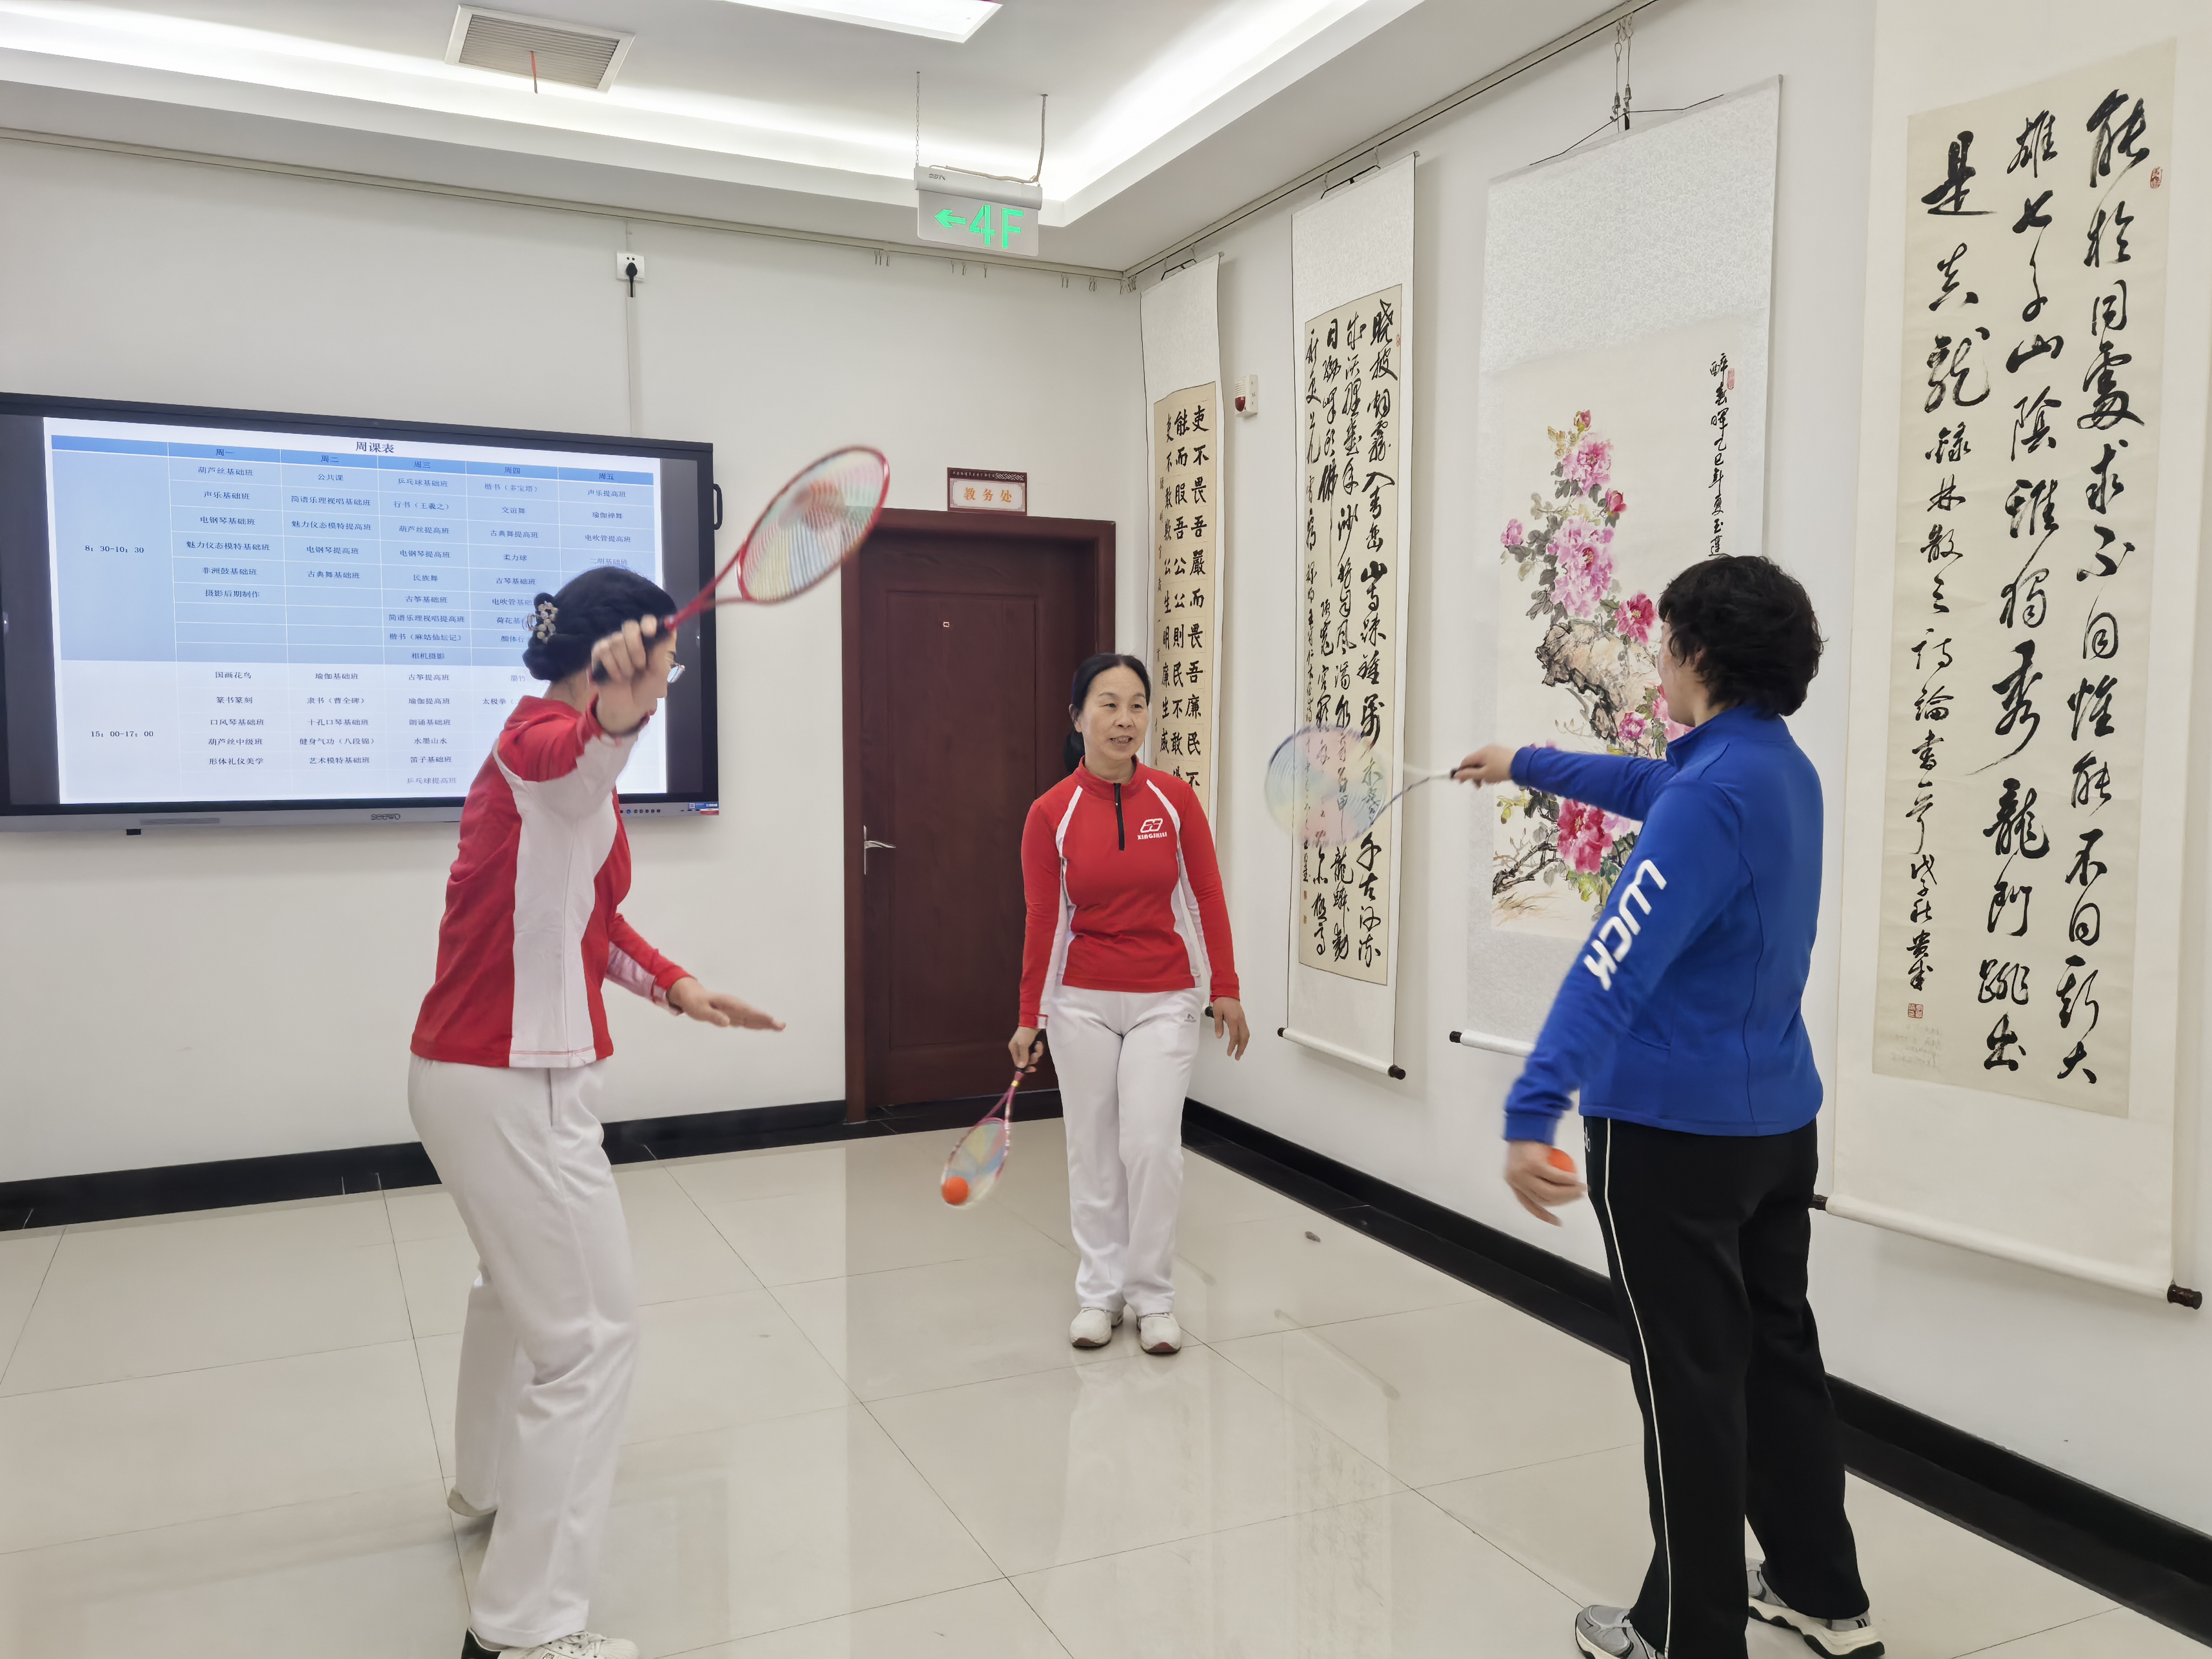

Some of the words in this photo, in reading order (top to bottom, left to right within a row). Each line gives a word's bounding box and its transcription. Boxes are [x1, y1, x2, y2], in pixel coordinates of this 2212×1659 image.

[969, 204, 1023, 248] 4F
[215, 448, 234, 456] 周一
[355, 441, 395, 454] 周课表
[320, 455, 339, 463] 周二
[414, 461, 431, 469] 周三
[198, 466, 254, 476] 葫芦丝基础班
[398, 478, 448, 487] 乒乓球基础班
[204, 491, 250, 500] 声乐基础班
[588, 489, 626, 497] 声乐提高班
[964, 487, 1013, 503] 教务处
[291, 495, 371, 506] 简谱乐理视唱基础班
[200, 516, 255, 525] 电钢琴基础班
[291, 520, 372, 530] 魅力仪态模特提高班
[399, 525, 449, 534] 葫芦丝提高班
[490, 530, 538, 538] 古典舞提高班
[585, 534, 631, 543] 电吹管提高班
[186, 541, 270, 550] 魅力仪态模特基础班
[306, 546, 359, 555] 电钢琴提高班
[400, 550, 450, 558] 电钢琴提高班
[203, 567, 257, 575] 非洲鼓基础班
[308, 570, 360, 579] 古典舞基础班
[205, 589, 260, 598] 摄影后期制作
[389, 613, 465, 623] 简谱乐理视唱提高班
[1583, 859, 1667, 991] LUCK
